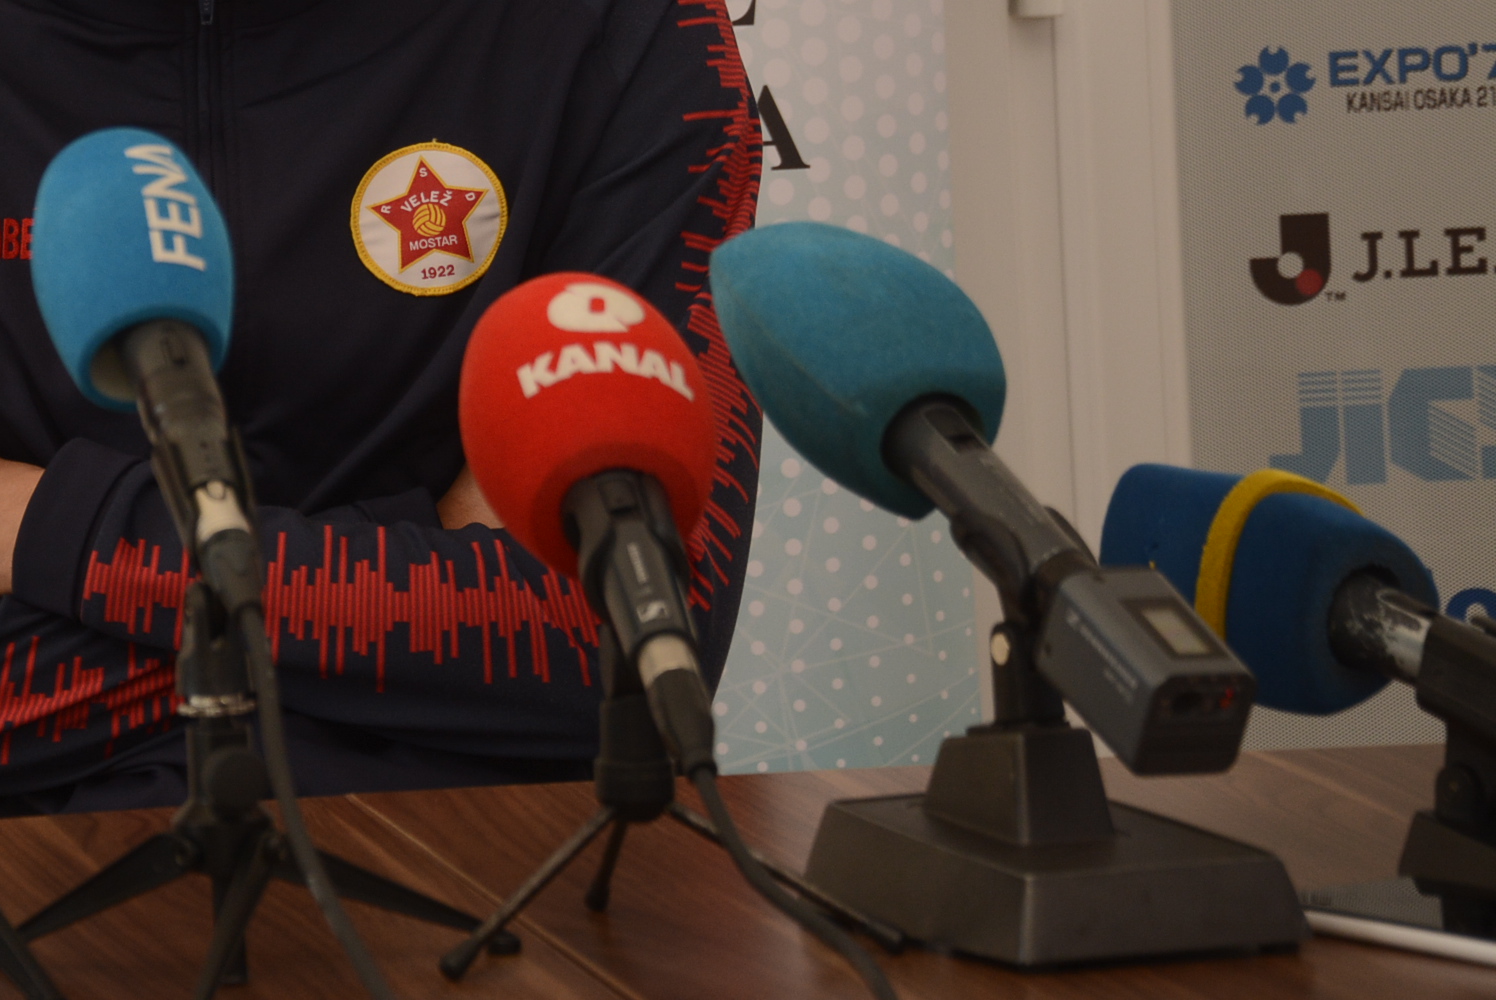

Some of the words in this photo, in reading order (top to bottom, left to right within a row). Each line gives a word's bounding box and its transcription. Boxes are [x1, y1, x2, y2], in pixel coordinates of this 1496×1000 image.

[1413, 87, 1471, 111] OSAKA
[124, 143, 207, 272] FENA
[400, 189, 454, 213] VELEŽ
[409, 234, 459, 252] MOSTAR
[1352, 226, 1496, 283] J.LE
[420, 264, 456, 280] 1922
[516, 340, 695, 403] KANAL
